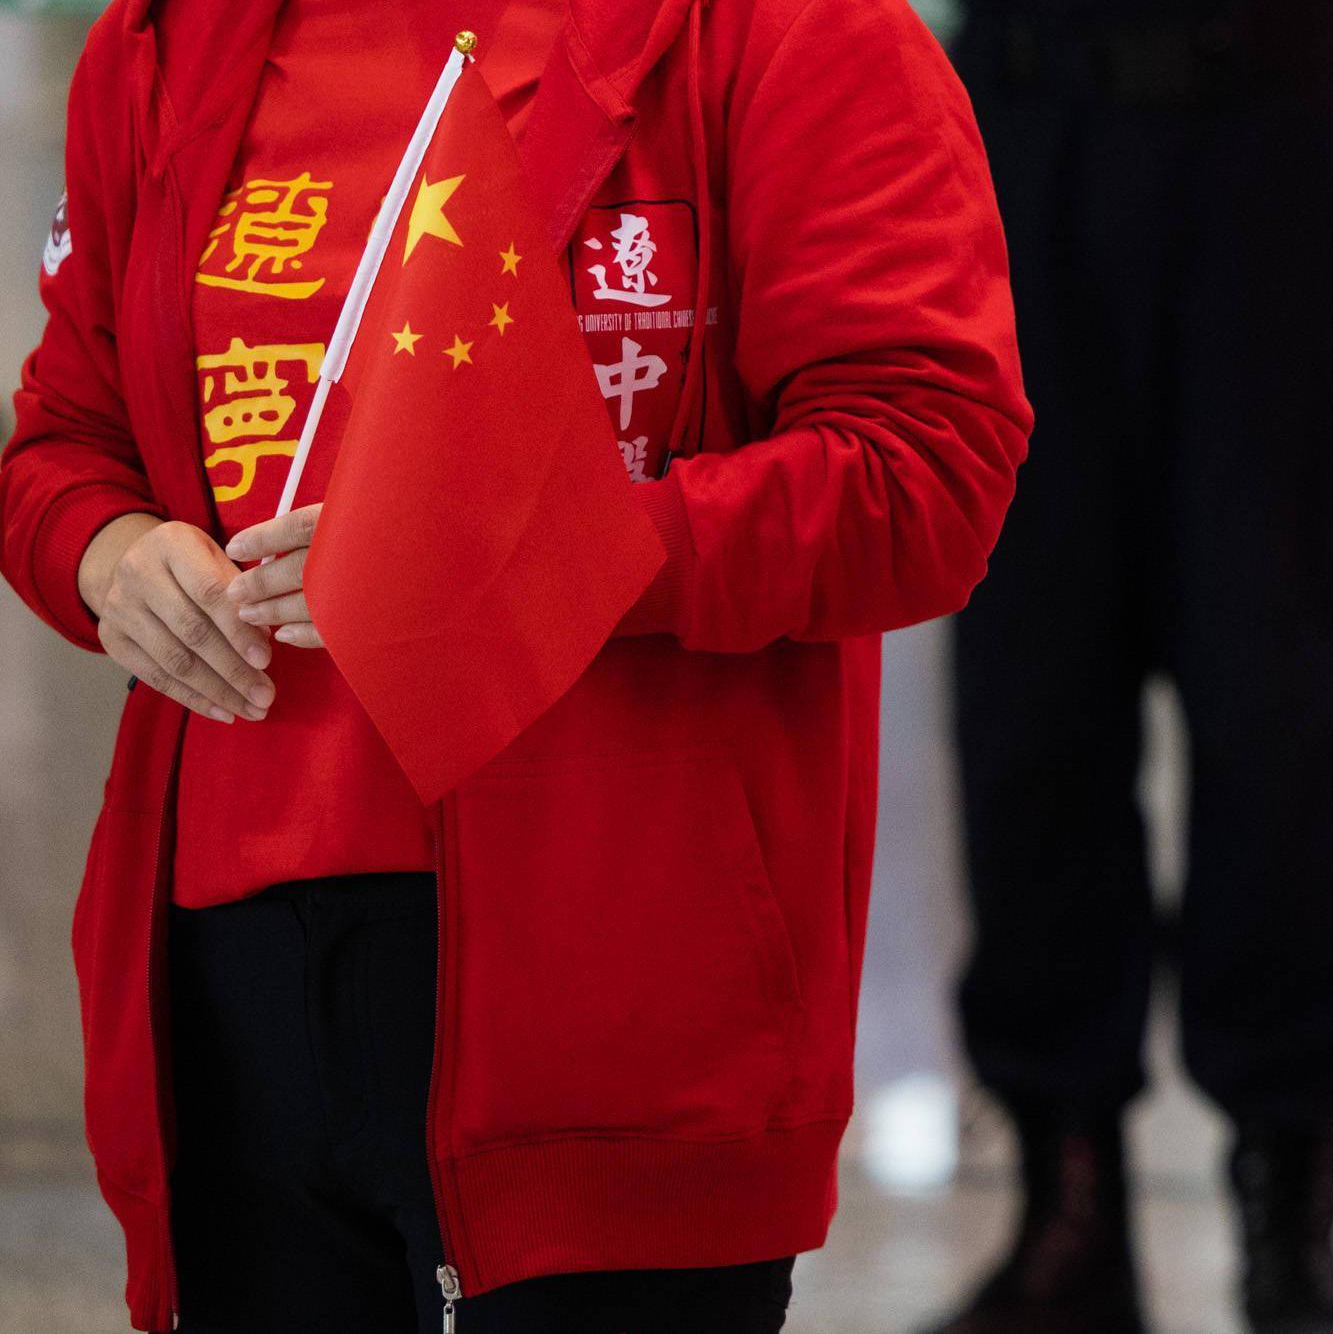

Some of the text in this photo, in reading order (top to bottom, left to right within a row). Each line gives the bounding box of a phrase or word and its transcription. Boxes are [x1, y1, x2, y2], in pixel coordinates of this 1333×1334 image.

[585, 313, 623, 332] UNIVERSITY
[624, 312, 632, 331] OF
[634, 310, 672, 330] TRADITIONAL
